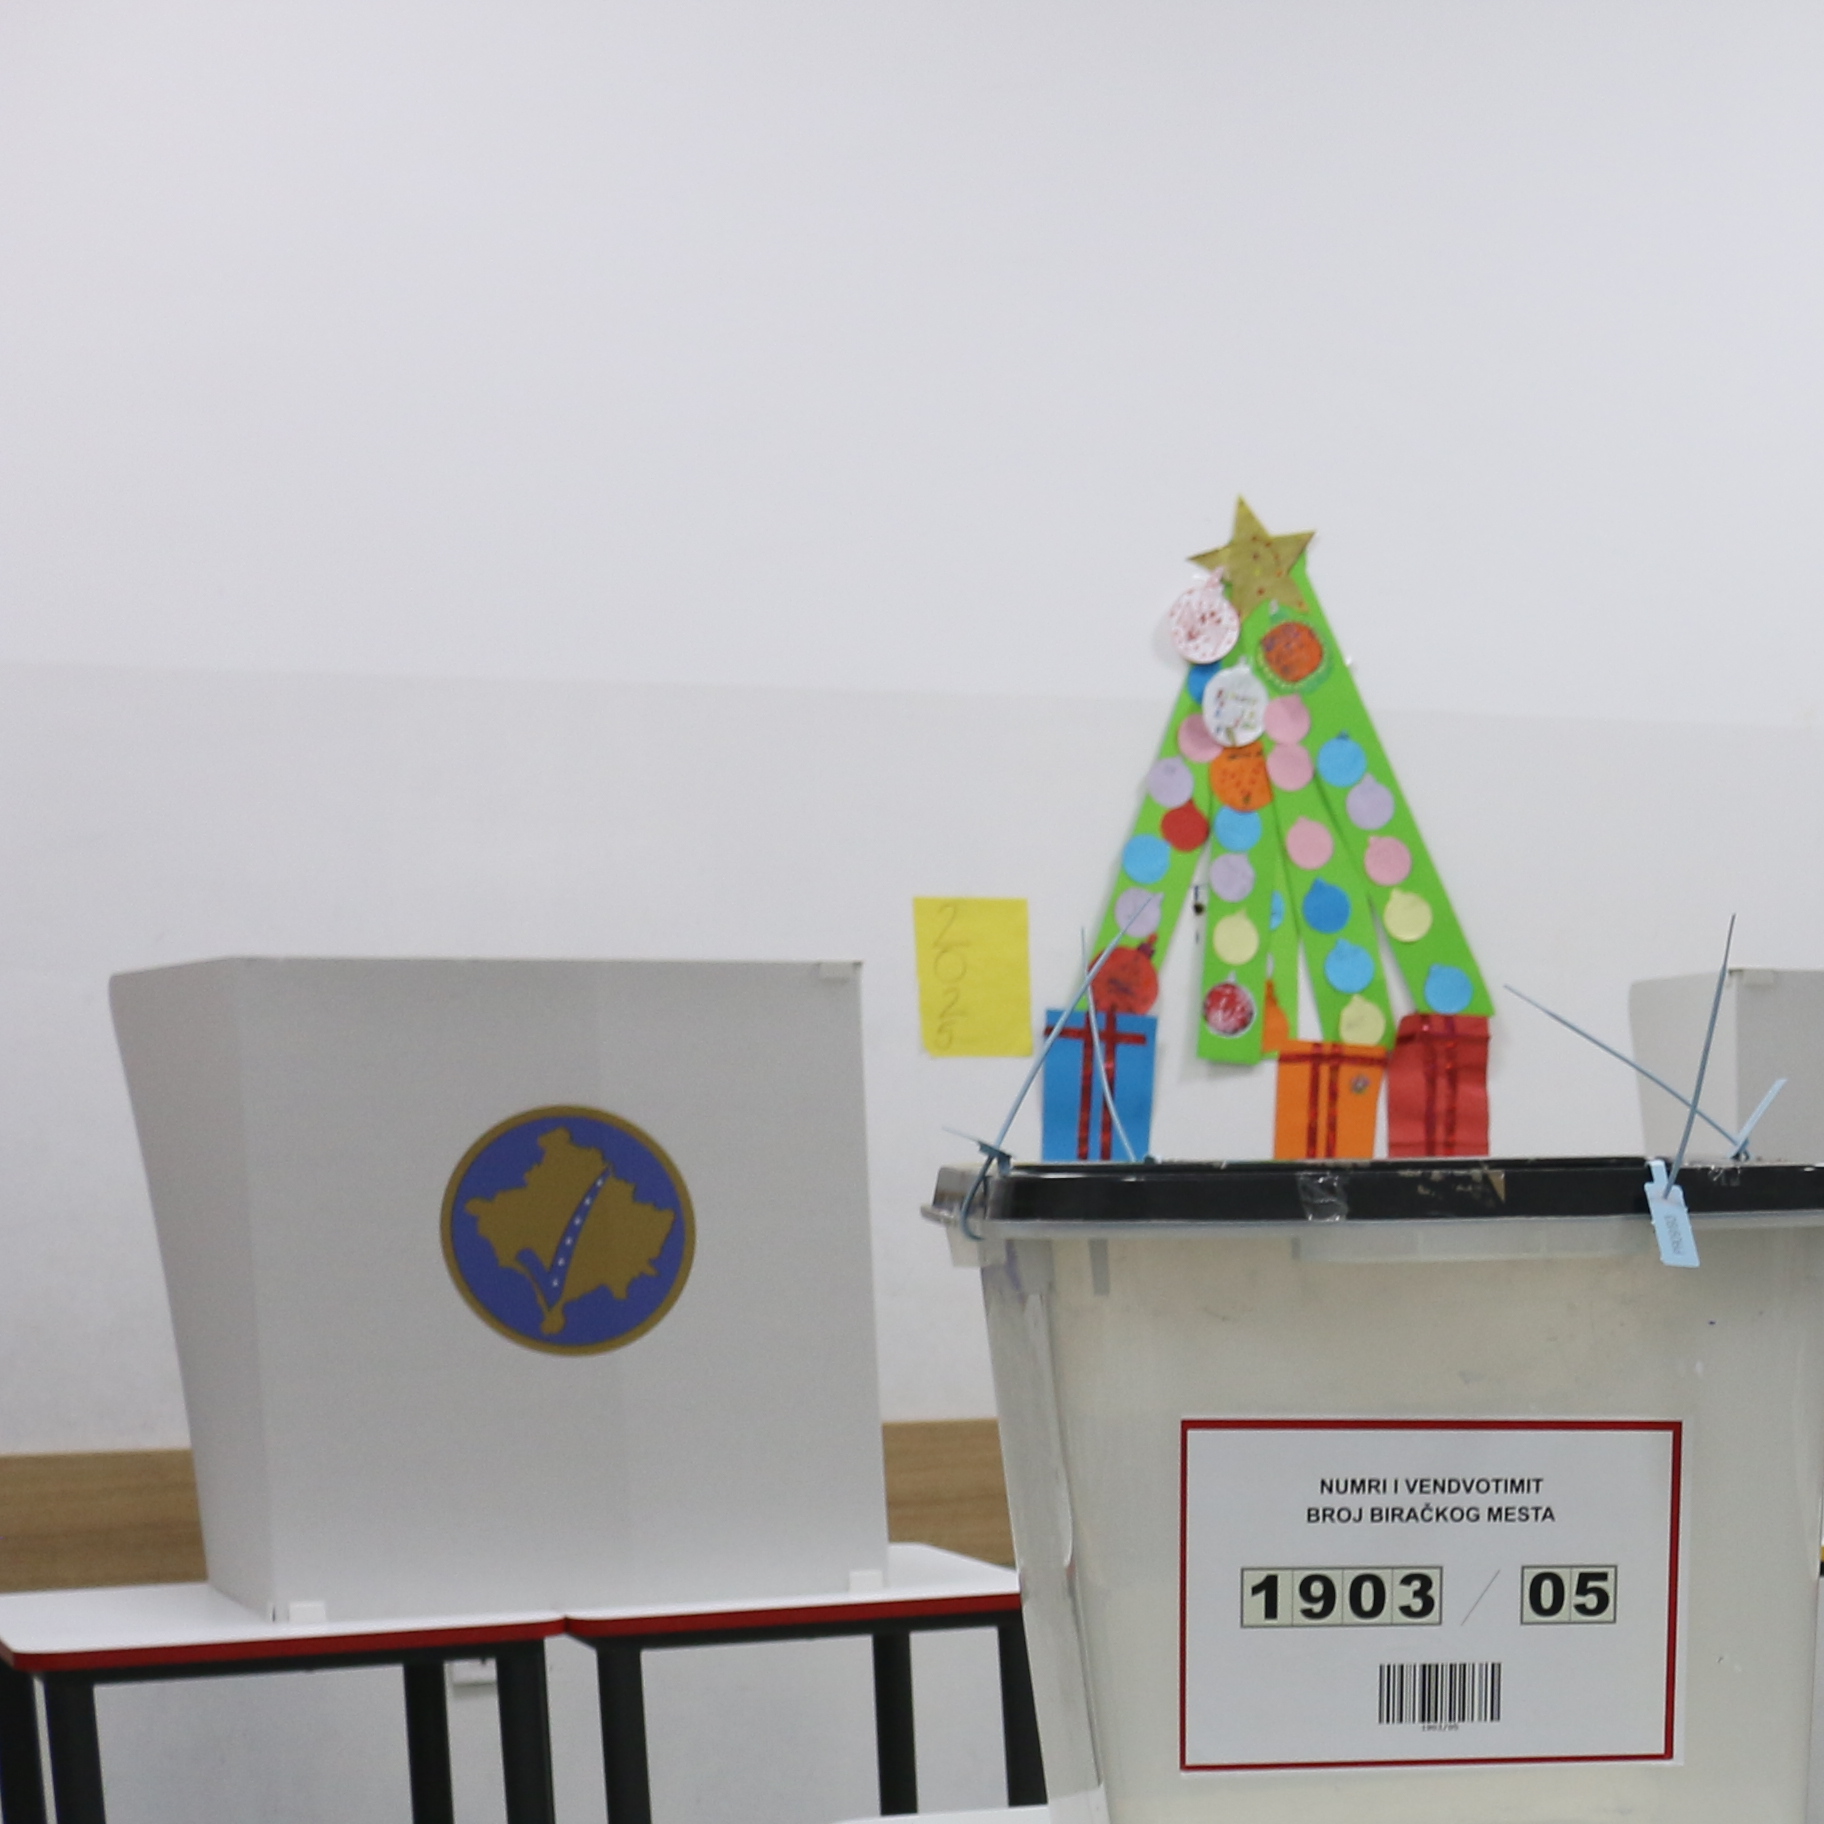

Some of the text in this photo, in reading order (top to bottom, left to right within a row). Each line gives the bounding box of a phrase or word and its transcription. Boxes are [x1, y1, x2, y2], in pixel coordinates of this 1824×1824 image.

[932, 902, 971, 1050] 2025
[1319, 1477, 1544, 1495] NUMRI I VENDVOTIMIT
[1306, 1502, 1556, 1524] BROJ BIRAČKOG MESTA
[1251, 1573, 1435, 1621] 1903
[1528, 1571, 1610, 1618] 05
